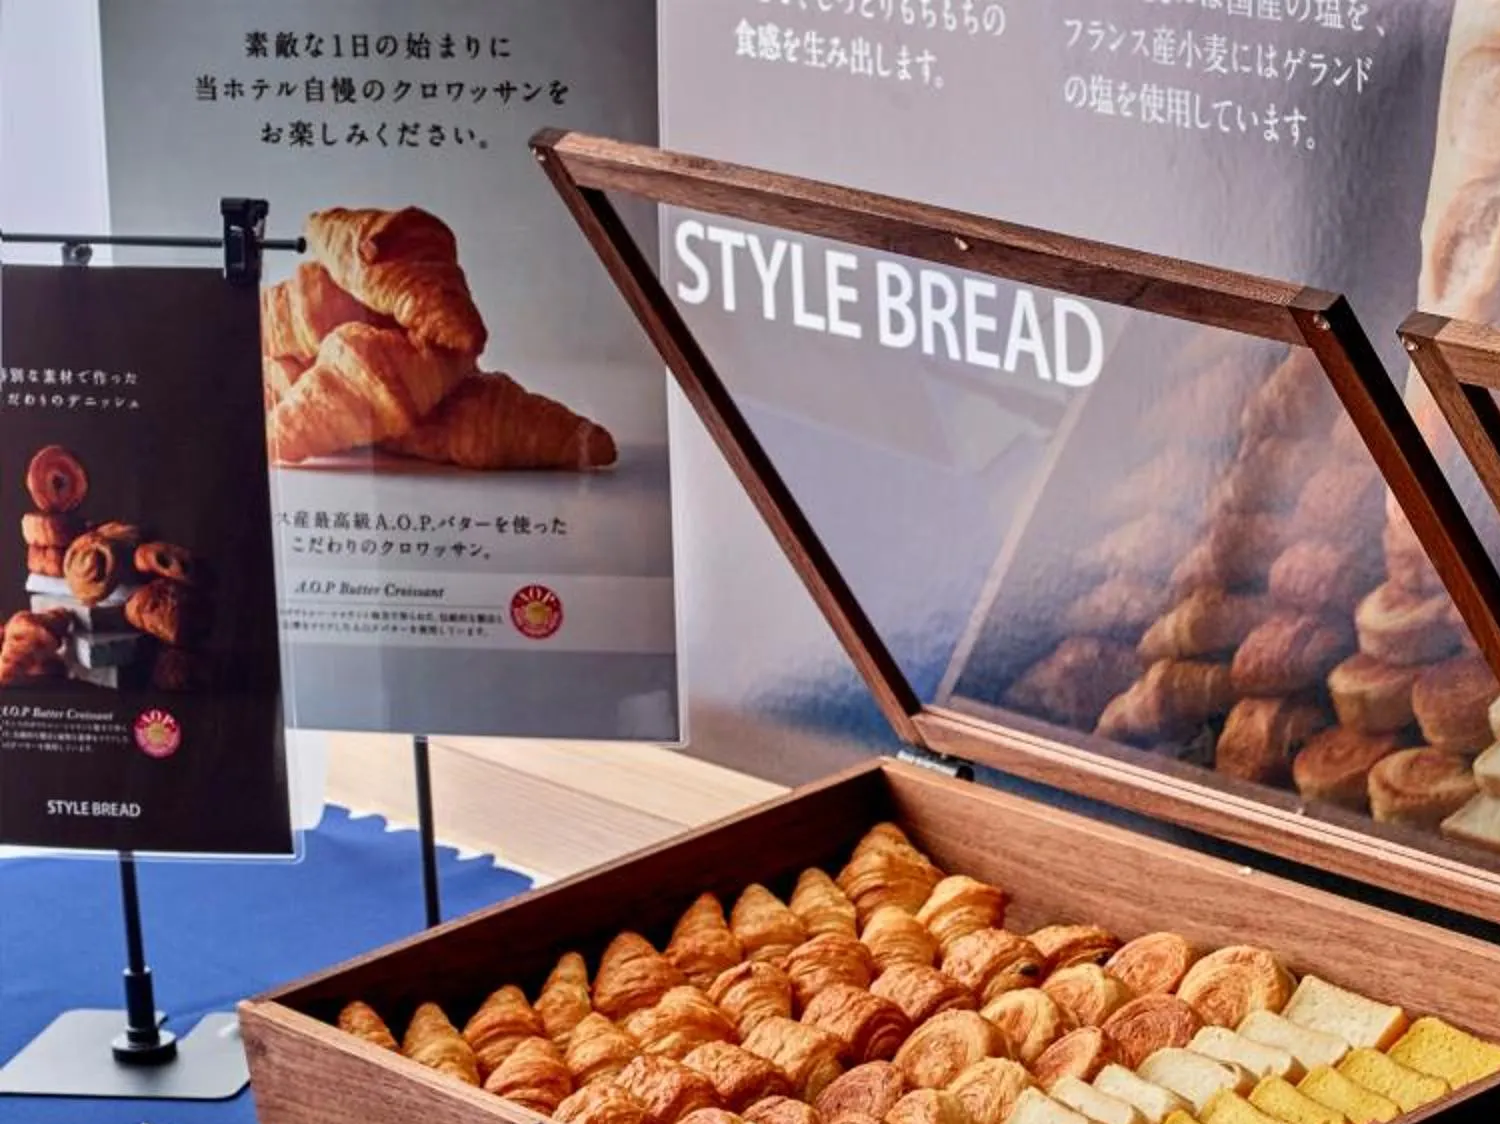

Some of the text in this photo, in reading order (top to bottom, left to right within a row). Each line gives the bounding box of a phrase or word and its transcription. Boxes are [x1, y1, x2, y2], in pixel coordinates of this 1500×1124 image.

[245, 31, 511, 60] 素敵な1日の始まりに
[735, 17, 944, 89] 食感を生み出します。
[1064, 19, 1373, 93] フランス産小麦にはゲランド
[195, 75, 569, 105] 当ホテル自慢のクロワッサンを
[1064, 74, 1315, 150] の塩を使用しています。
[260, 119, 489, 149] お楽しみください。
[674, 219, 1104, 388] STYLE BREAD
[292, 536, 490, 560] こだわりのクロワッサン。
[47, 799, 141, 818] STYLE BREAD
